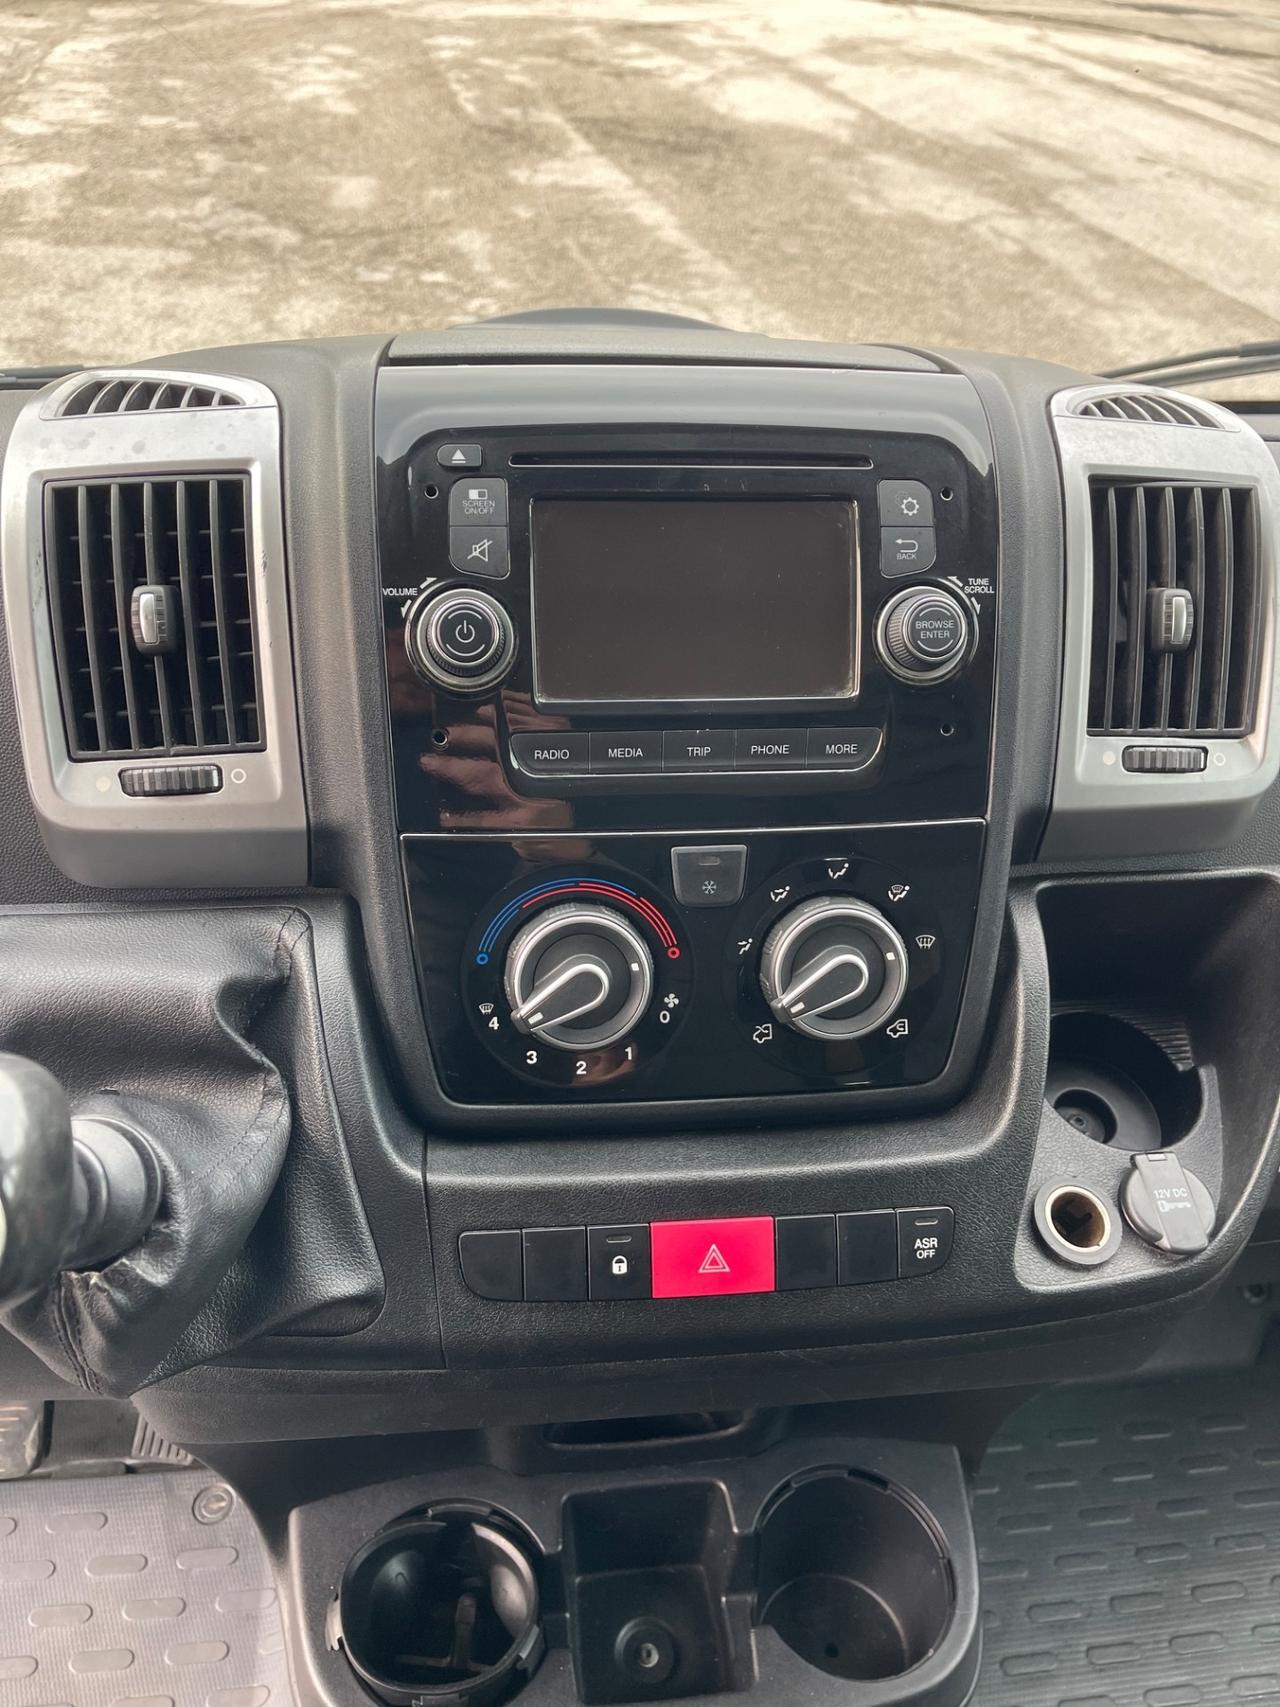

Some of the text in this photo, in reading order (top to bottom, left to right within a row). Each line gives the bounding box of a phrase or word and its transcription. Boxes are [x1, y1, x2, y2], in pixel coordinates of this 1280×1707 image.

[462, 500, 495, 508] SCREEN
[896, 553, 917, 562] BACK
[968, 578, 989, 586] TUNE
[382, 587, 418, 596] VOLUME
[964, 585, 995, 594] SCROLL
[915, 620, 955, 629] BROWSE
[920, 630, 950, 639] ENTER
[534, 749, 570, 760] RADIO
[608, 748, 644, 758] MEDIA
[686, 746, 711, 757] TRIP
[751, 745, 790, 756] PHONE
[826, 744, 858, 755] MORE
[489, 1017, 499, 1030] 4
[526, 1051, 537, 1065] 3
[625, 1048, 633, 1060] 1
[576, 1061, 587, 1075] 2
[1154, 1189, 1171, 1199] 12V
[914, 1238, 938, 1249] ASR
[916, 1249, 936, 1259] OFF
